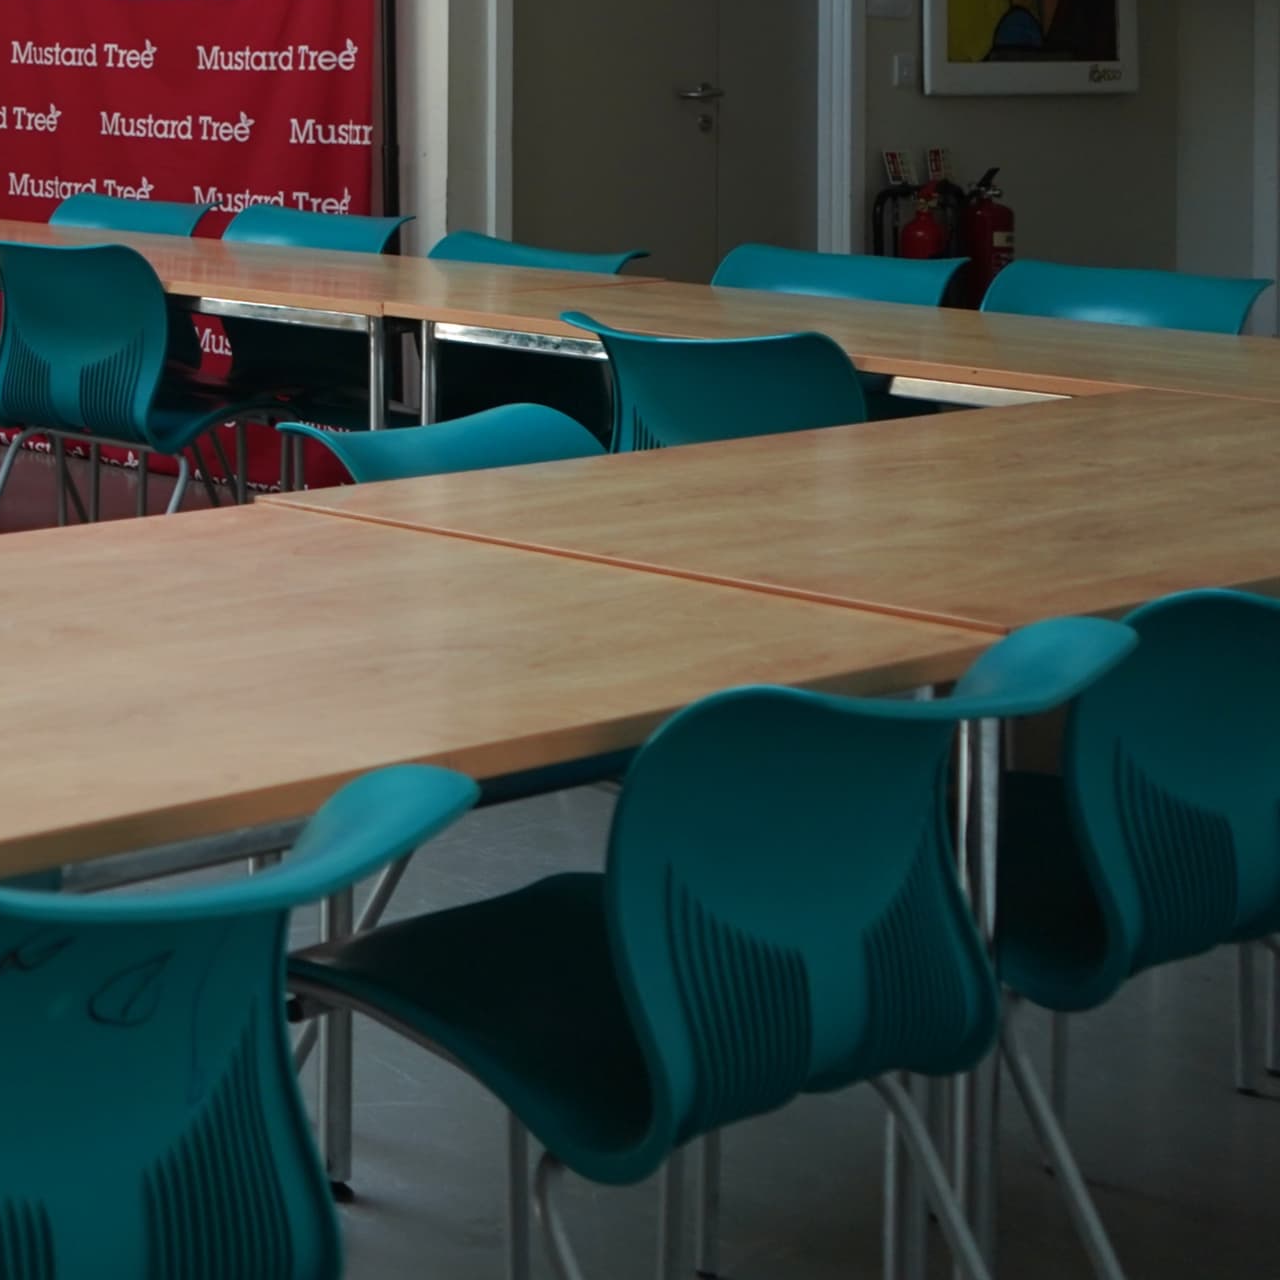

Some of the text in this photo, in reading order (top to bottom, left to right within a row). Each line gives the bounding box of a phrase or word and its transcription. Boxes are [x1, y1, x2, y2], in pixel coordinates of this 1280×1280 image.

[11, 40, 157, 68] Mustard Tree
[197, 39, 358, 71] Mustard Tree
[13, 104, 62, 132] Tree
[101, 112, 254, 142] Mustard Tree
[9, 172, 96, 199] Mustard
